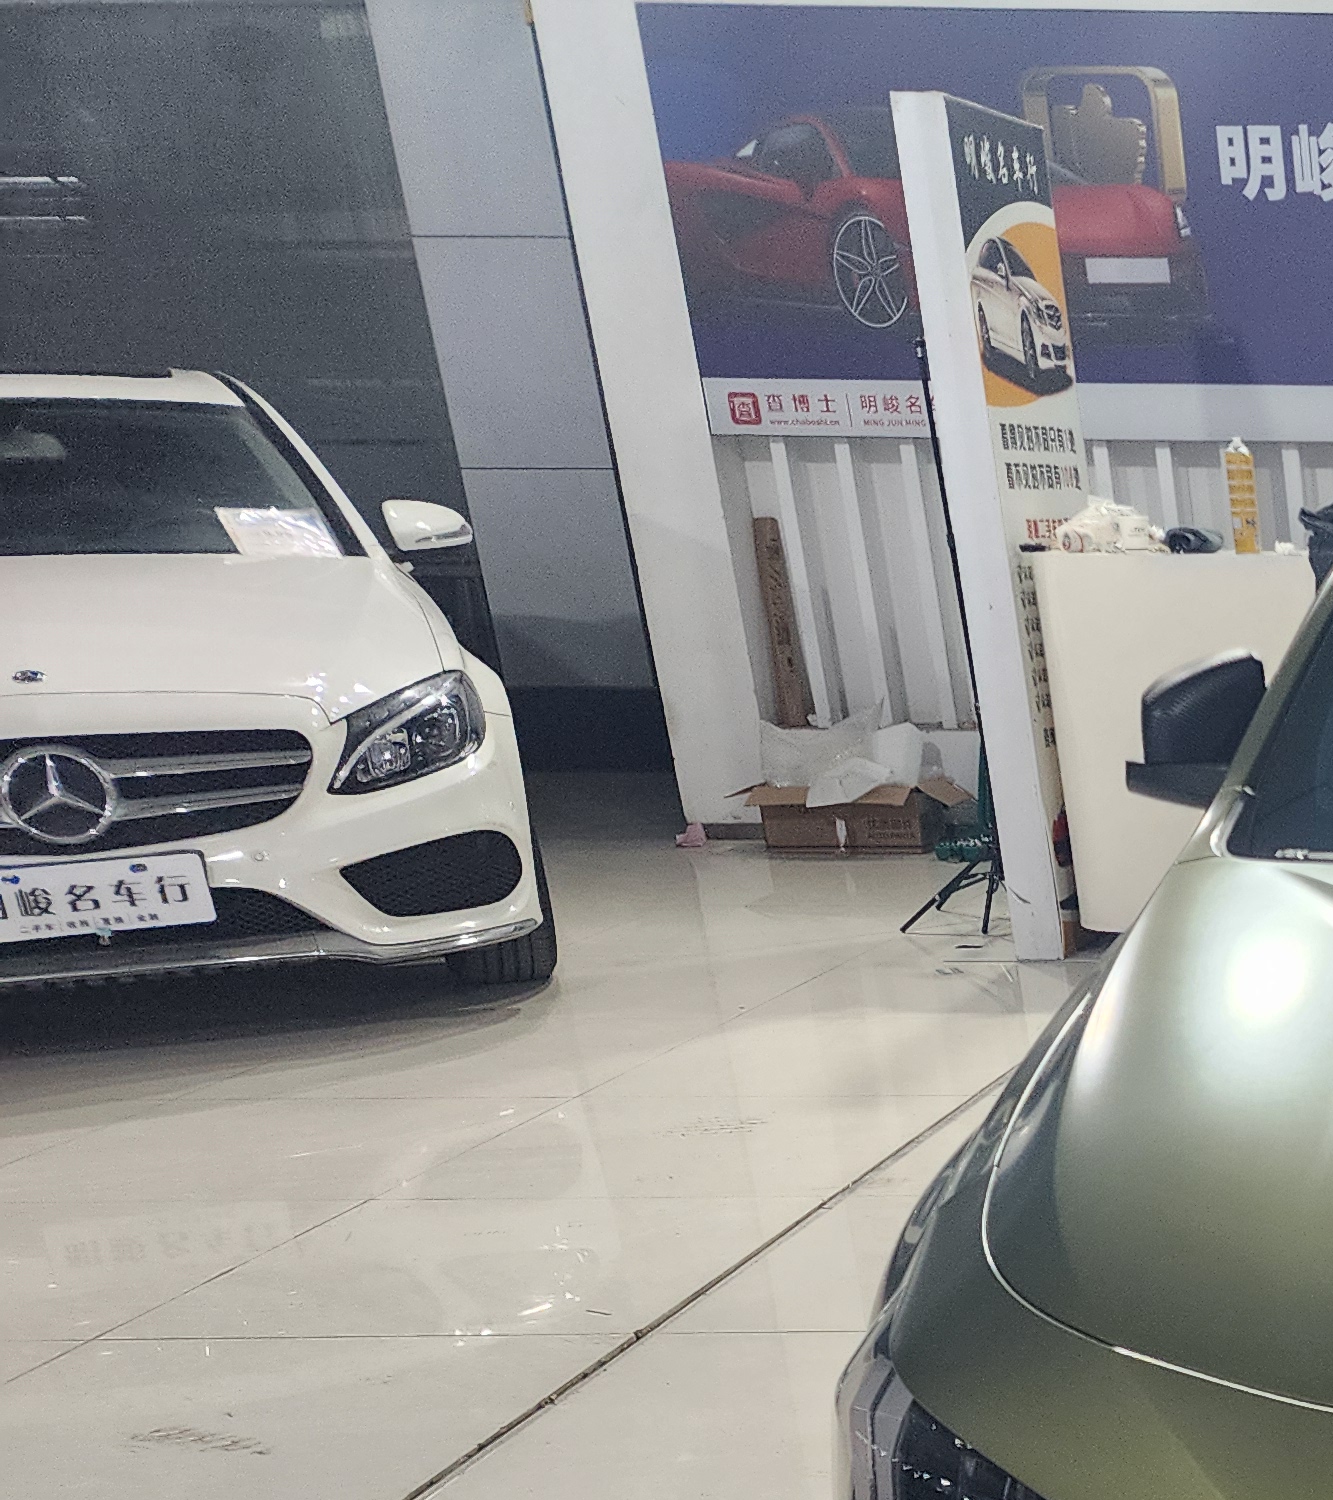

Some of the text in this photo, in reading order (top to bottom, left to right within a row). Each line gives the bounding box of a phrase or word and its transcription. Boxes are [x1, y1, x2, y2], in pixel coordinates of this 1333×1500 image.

[764, 393, 837, 413] 查博士
[860, 394, 936, 415] 明峻名
[864, 418, 927, 427] MING JUN MING
